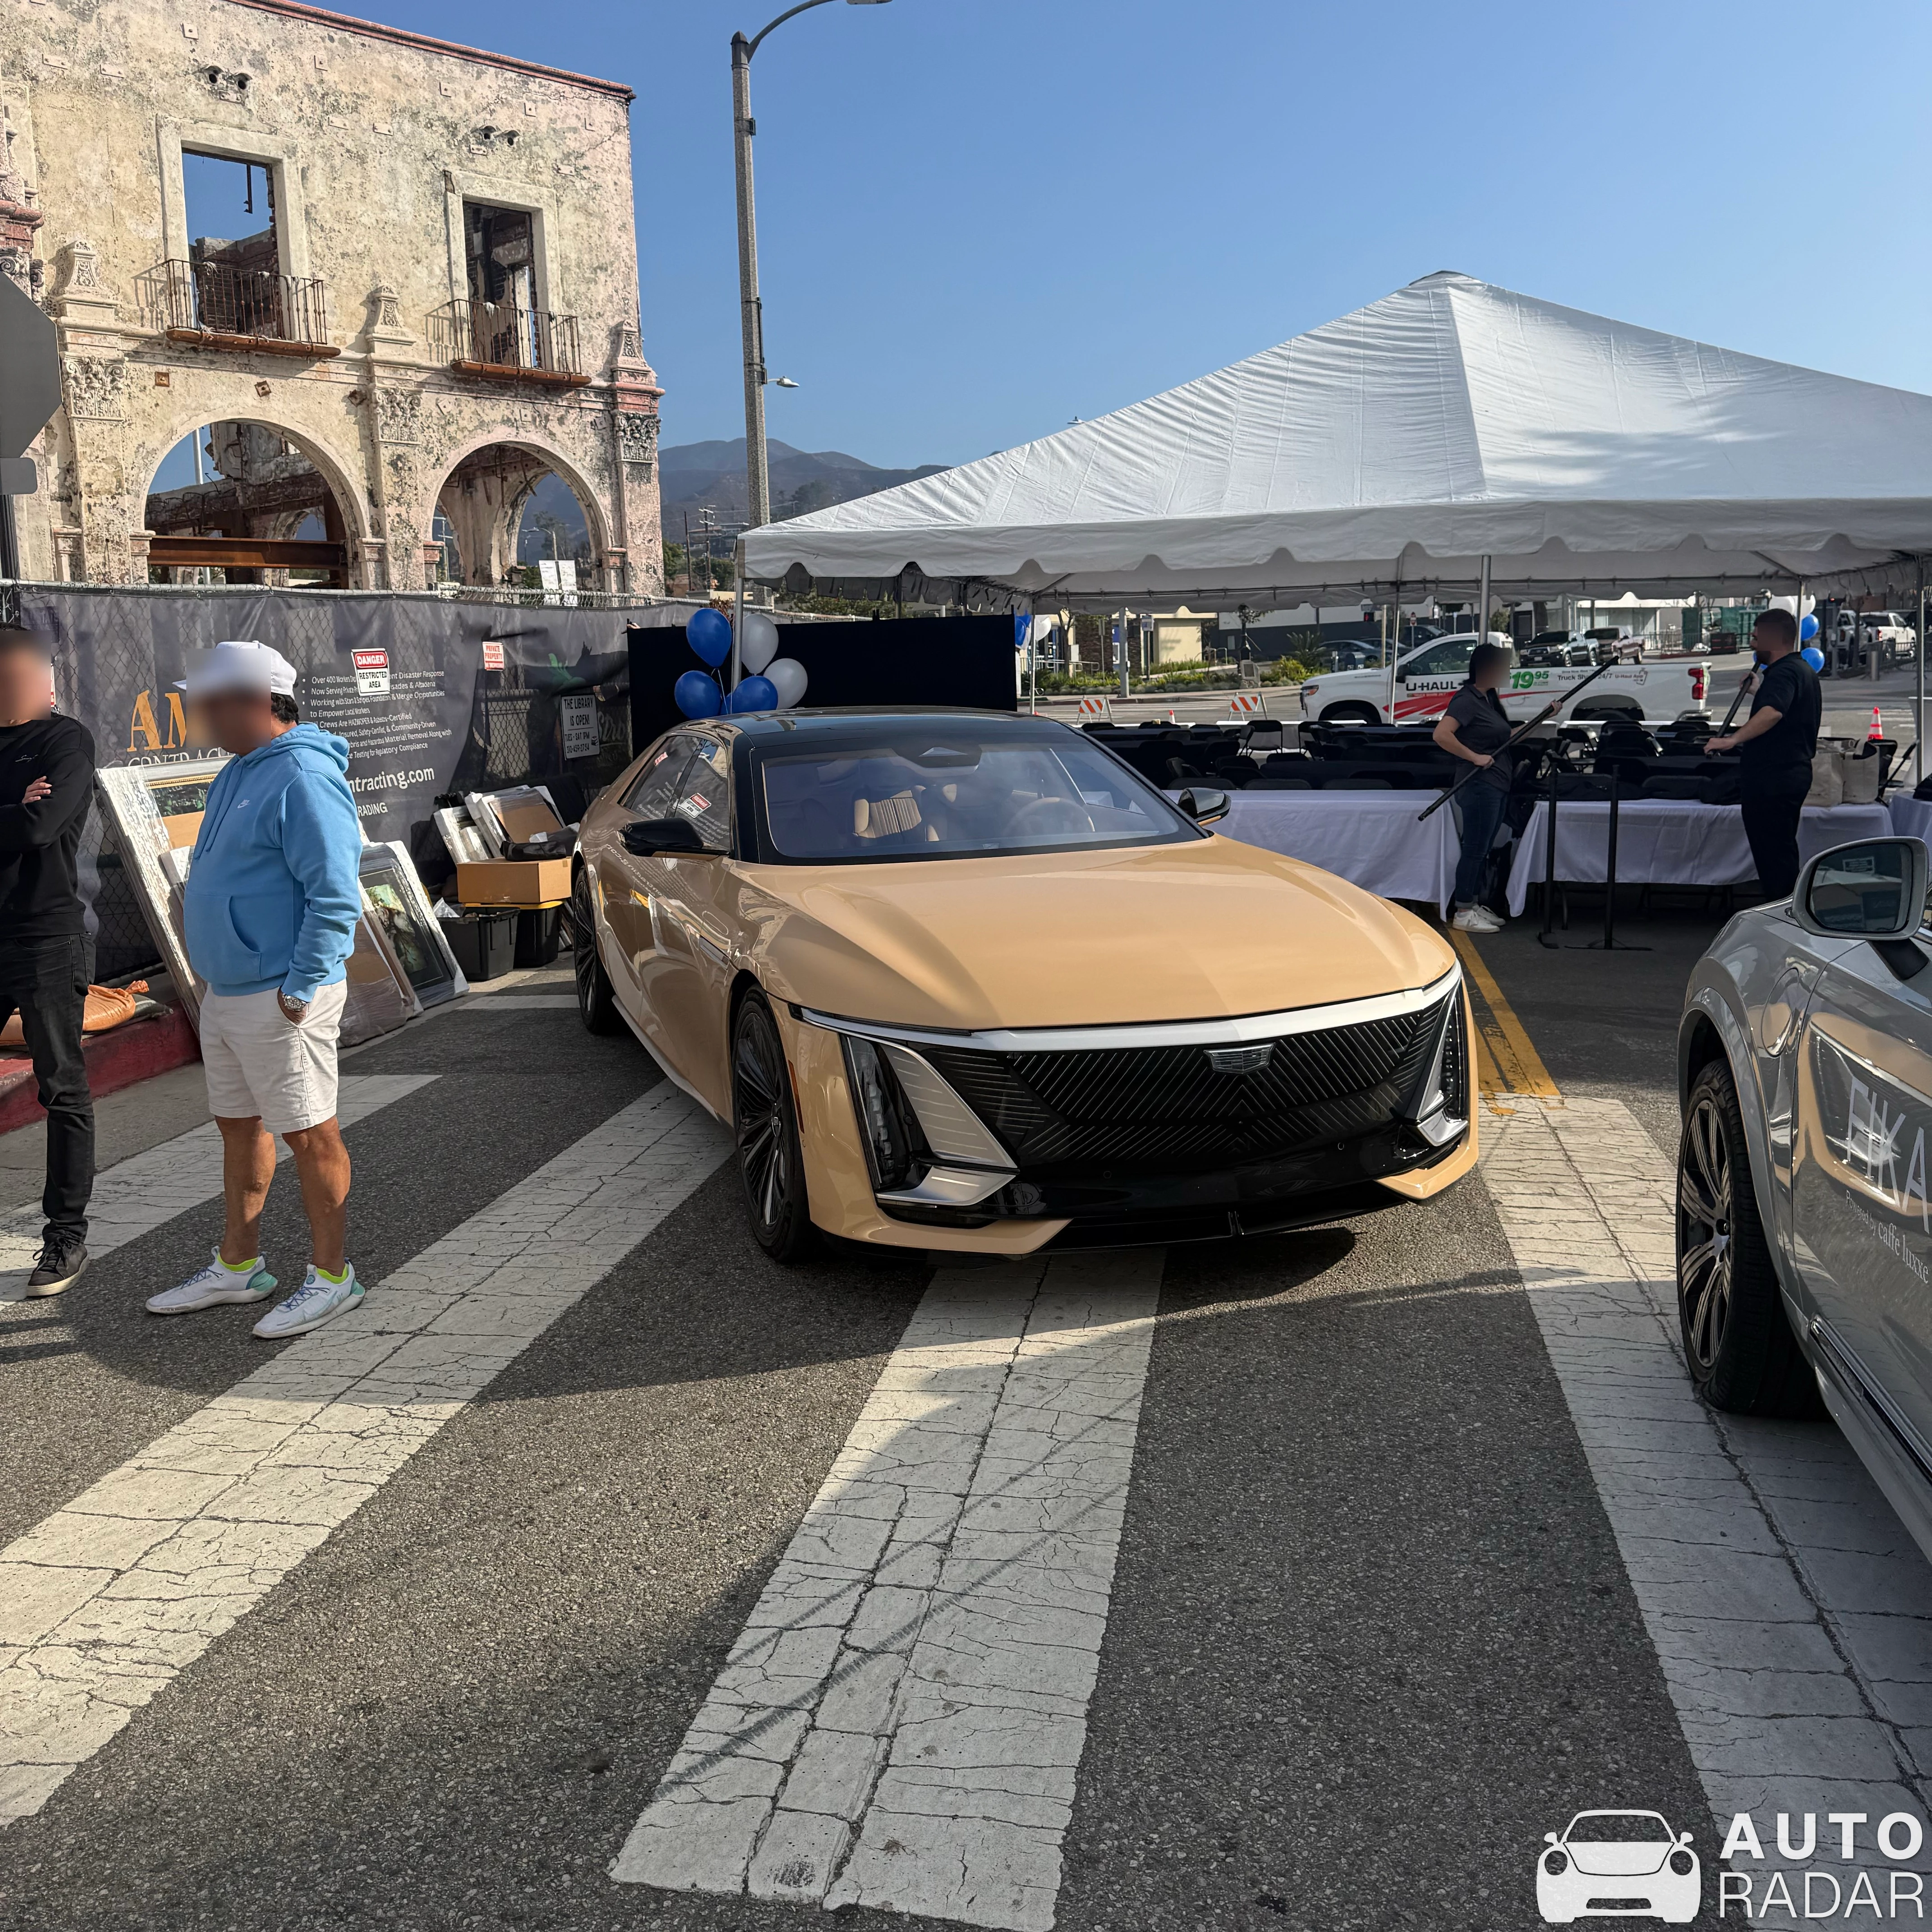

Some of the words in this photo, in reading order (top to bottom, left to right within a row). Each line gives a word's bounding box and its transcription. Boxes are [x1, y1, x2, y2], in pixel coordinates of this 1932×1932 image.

[356, 655, 385, 665] DANGER
[399, 672, 422, 680] Disaster
[423, 671, 444, 679] Response
[326, 687, 343, 695] Serving
[1406, 681, 1457, 691] U-HAUL
[310, 699, 335, 707] Working
[564, 699, 573, 710] THE
[574, 697, 593, 709] LIBRARY
[319, 709, 344, 718] Empower
[570, 716, 574, 726] IS
[575, 714, 590, 726] OPEN!
[391, 721, 436, 731] Community-Driven
[385, 734, 407, 744] Material
[407, 731, 429, 740] Removal
[354, 749, 369, 759] Testing
[399, 742, 428, 752] Compliance
[1847, 1075, 1929, 1235] FIKA
[1878, 1222, 1900, 1256] caffe
[1902, 1234, 1928, 1284] luxxe
